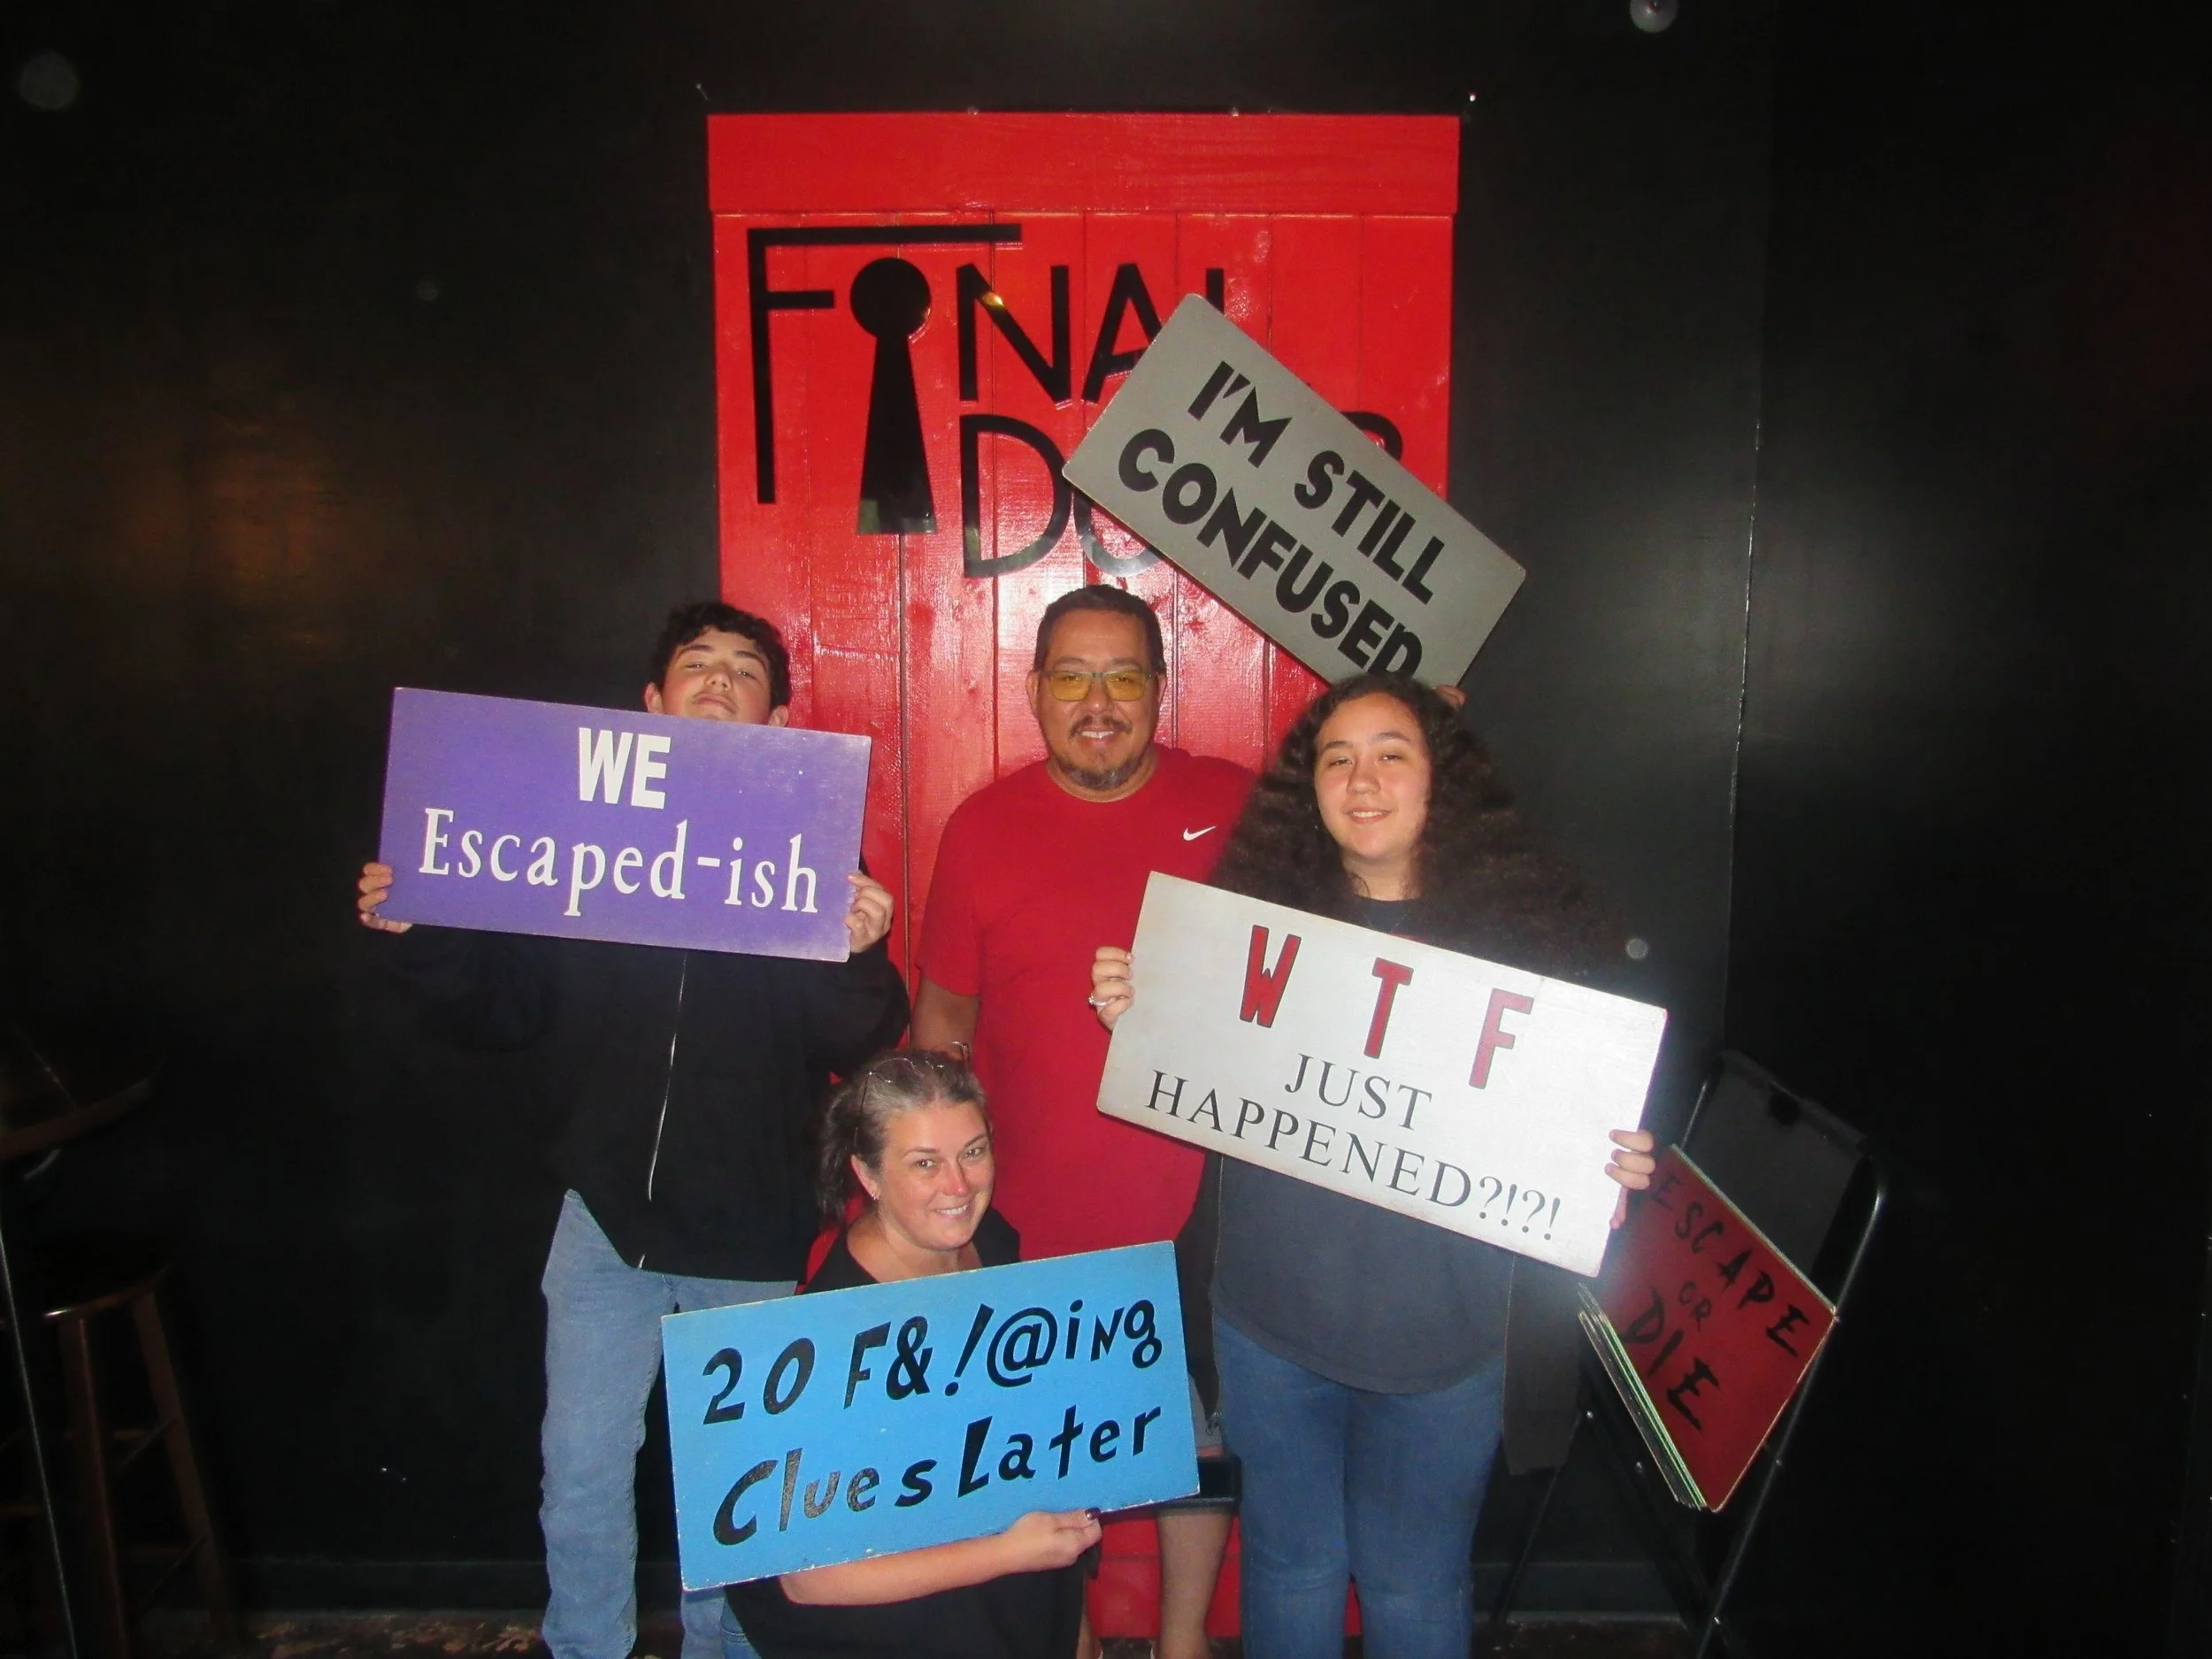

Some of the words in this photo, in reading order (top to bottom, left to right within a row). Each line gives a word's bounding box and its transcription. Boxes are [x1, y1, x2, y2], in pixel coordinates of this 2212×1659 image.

[1118, 428, 1423, 678] CONFUSED
[1187, 360, 1293, 468] I'M
[1294, 449, 1433, 605] STILL
[579, 726, 672, 810] WE
[419, 808, 818, 916] Escaped-ish
[1145, 1070, 1562, 1240] HAPPENED?!?!
[1285, 1053, 1432, 1131] JUST
[1650, 1171, 1811, 1358] ESCAPE
[1678, 1279, 1711, 1331] OR
[702, 1337, 816, 1425] 20
[1622, 1284, 1721, 1432] DIE
[712, 1448, 938, 1546] Clues
[957, 1404, 1161, 1498] Later
